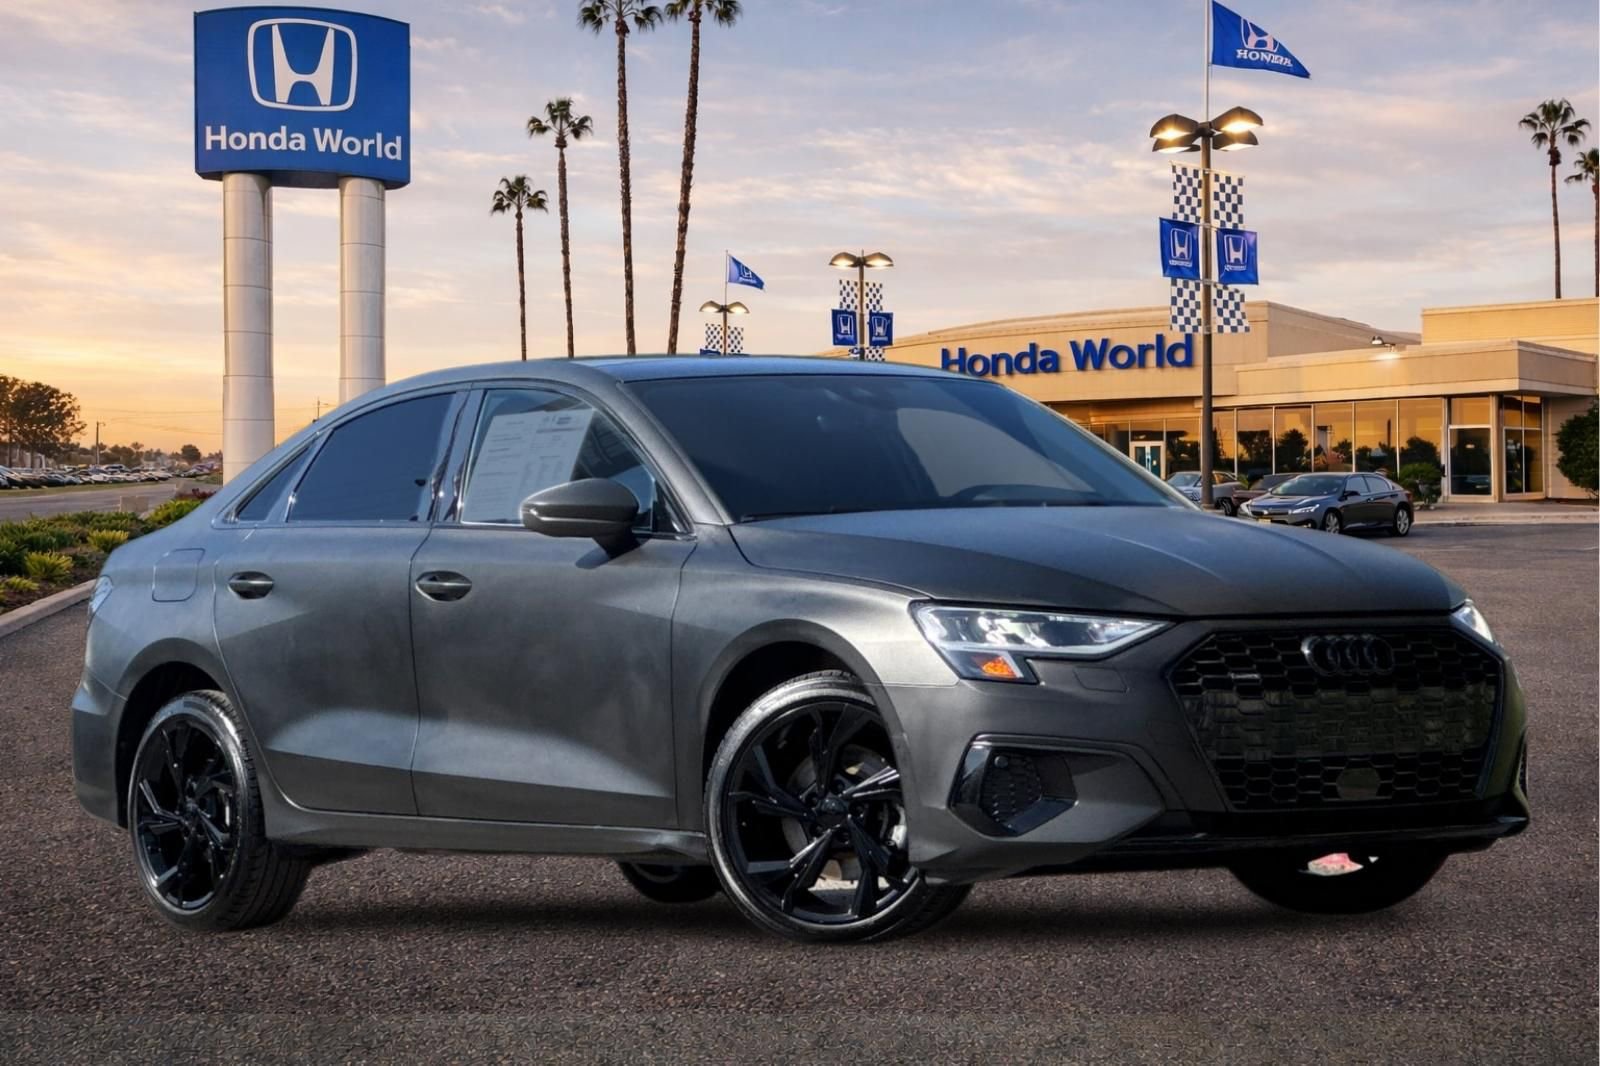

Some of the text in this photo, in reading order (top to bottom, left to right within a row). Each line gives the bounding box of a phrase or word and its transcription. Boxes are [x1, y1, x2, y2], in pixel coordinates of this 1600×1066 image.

[205, 125, 402, 161] Honda World
[941, 333, 1194, 377] Honda World
